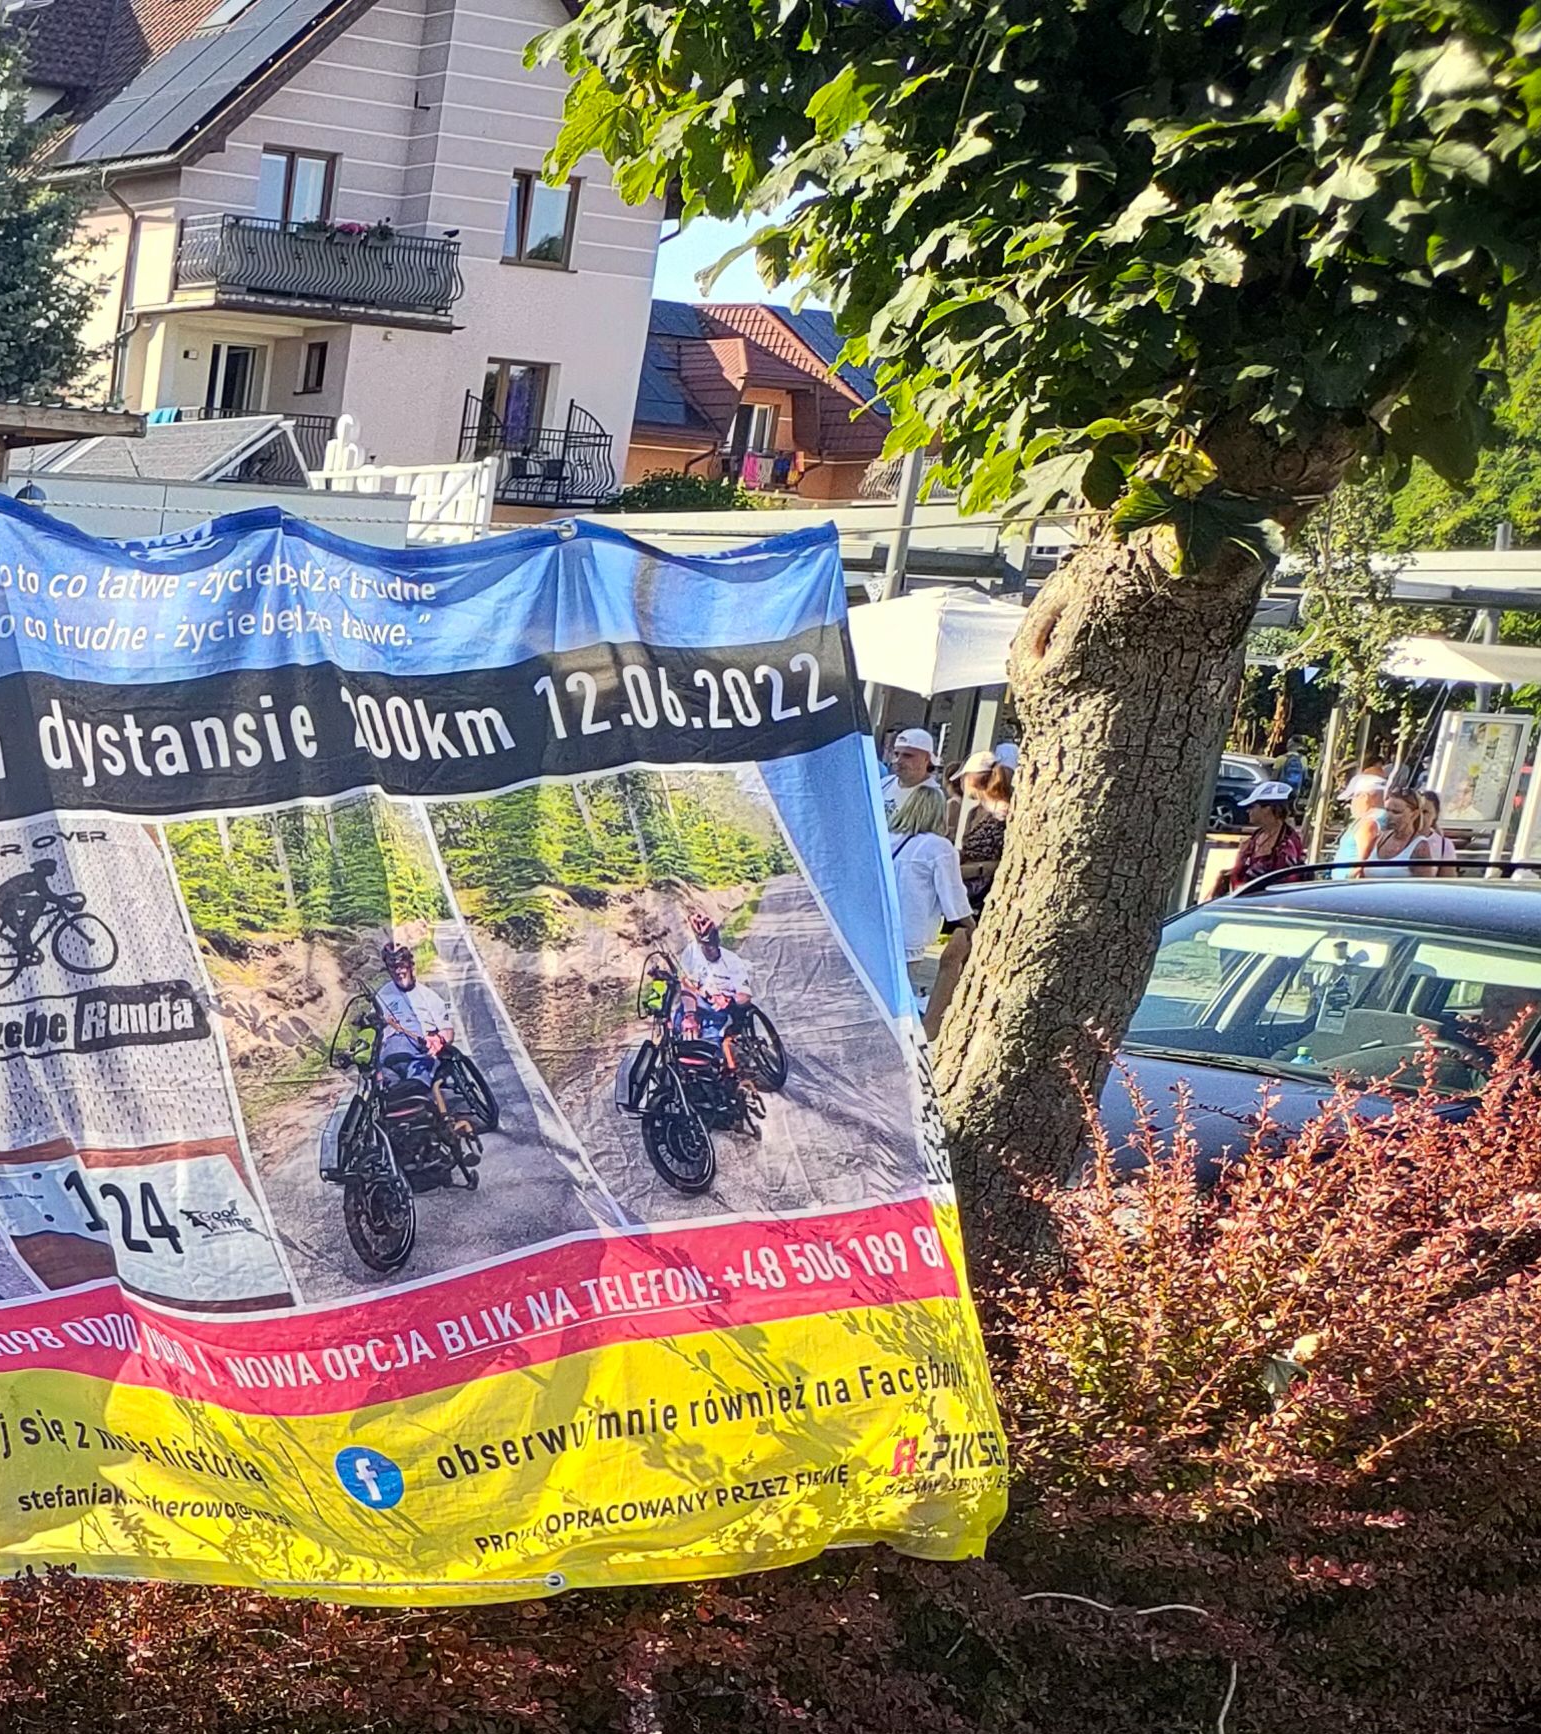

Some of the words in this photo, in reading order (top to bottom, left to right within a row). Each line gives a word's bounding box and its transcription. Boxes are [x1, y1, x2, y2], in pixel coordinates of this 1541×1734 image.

[18, 564, 39, 594] to
[48, 573, 88, 599] co
[97, 566, 180, 600] łatwe
[199, 560, 271, 604] życie
[350, 571, 437, 602] trudne
[24, 615, 47, 642] co
[53, 618, 147, 652] trudne
[173, 611, 256, 653] życie
[38, 694, 319, 788] dystansie
[533, 652, 839, 740] 12.06.2022
[81, 994, 195, 1044] Runda
[64, 1170, 185, 1255] 124
[225, 1355, 322, 1389] NOWA
[323, 1331, 437, 1382] OPCJA
[437, 1302, 524, 1355] BLIK
[525, 1287, 580, 1332] NA
[580, 1265, 720, 1315] TELEFON:
[722, 1247, 787, 1291] +48
[783, 1242, 852, 1283] 506
[848, 1232, 908, 1278] 189
[597, 1398, 678, 1440] mnie
[690, 1376, 807, 1426] również
[816, 1377, 851, 1408] na
[19, 1409, 70, 1453] się
[75, 1420, 91, 1449] z
[156, 1437, 270, 1489] historią
[546, 1489, 708, 1534] OPRACOWANY
[717, 1476, 791, 1507] PRZEZ
